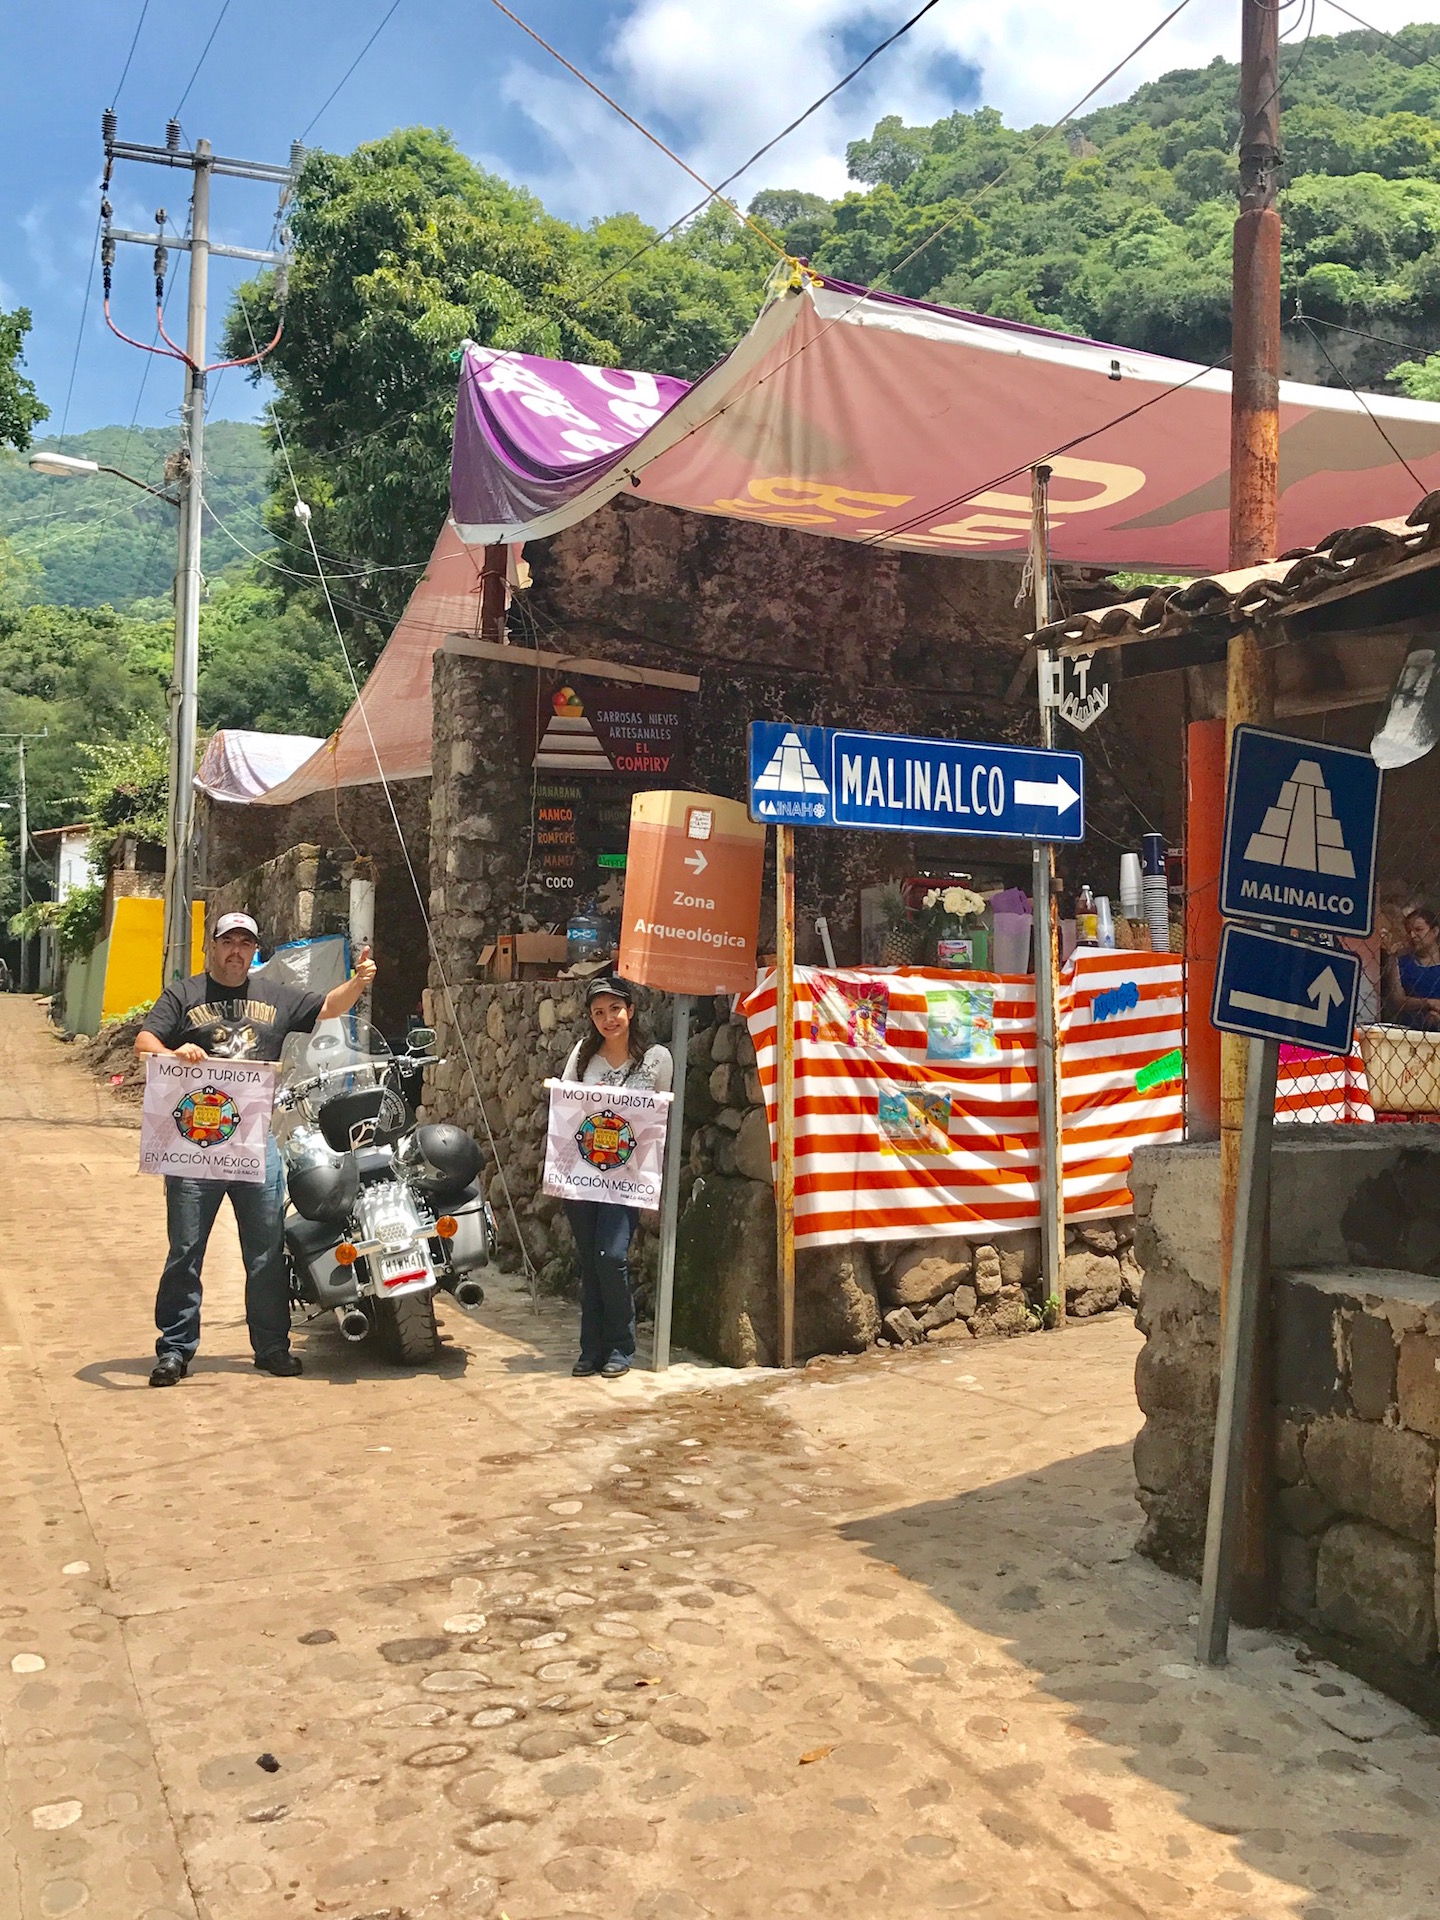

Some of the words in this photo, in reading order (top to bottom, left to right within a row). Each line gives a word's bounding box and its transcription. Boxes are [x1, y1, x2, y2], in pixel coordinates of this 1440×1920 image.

[597, 711, 643, 725] SABROSAS
[648, 713, 679, 726] NIEVES
[609, 726, 672, 740] ARTESANALES
[635, 742, 650, 754] EL
[616, 755, 670, 772] COMPIRY
[841, 753, 1005, 818] MALINALCO
[538, 808, 573, 821] MANGO
[537, 831, 576, 844] ROMPOPE
[543, 854, 576, 867] MAMEY
[545, 876, 574, 889] COCO
[672, 890, 716, 911] Zona
[1240, 878, 1355, 917] MALINALCO
[633, 918, 747, 949] Arqueológica
[159, 1064, 203, 1079] MOTO
[207, 1068, 261, 1083] TURISTA
[562, 1089, 603, 1103] MOTO
[606, 1092, 656, 1109] TURISTA
[145, 1152, 159, 1163] EN
[162, 1151, 211, 1166] ACCIÓN
[213, 1154, 261, 1169] MÉXICO
[548, 1173, 563, 1184] EN
[565, 1174, 610, 1189] ACCIÓN
[611, 1178, 655, 1195] MÉXICO
